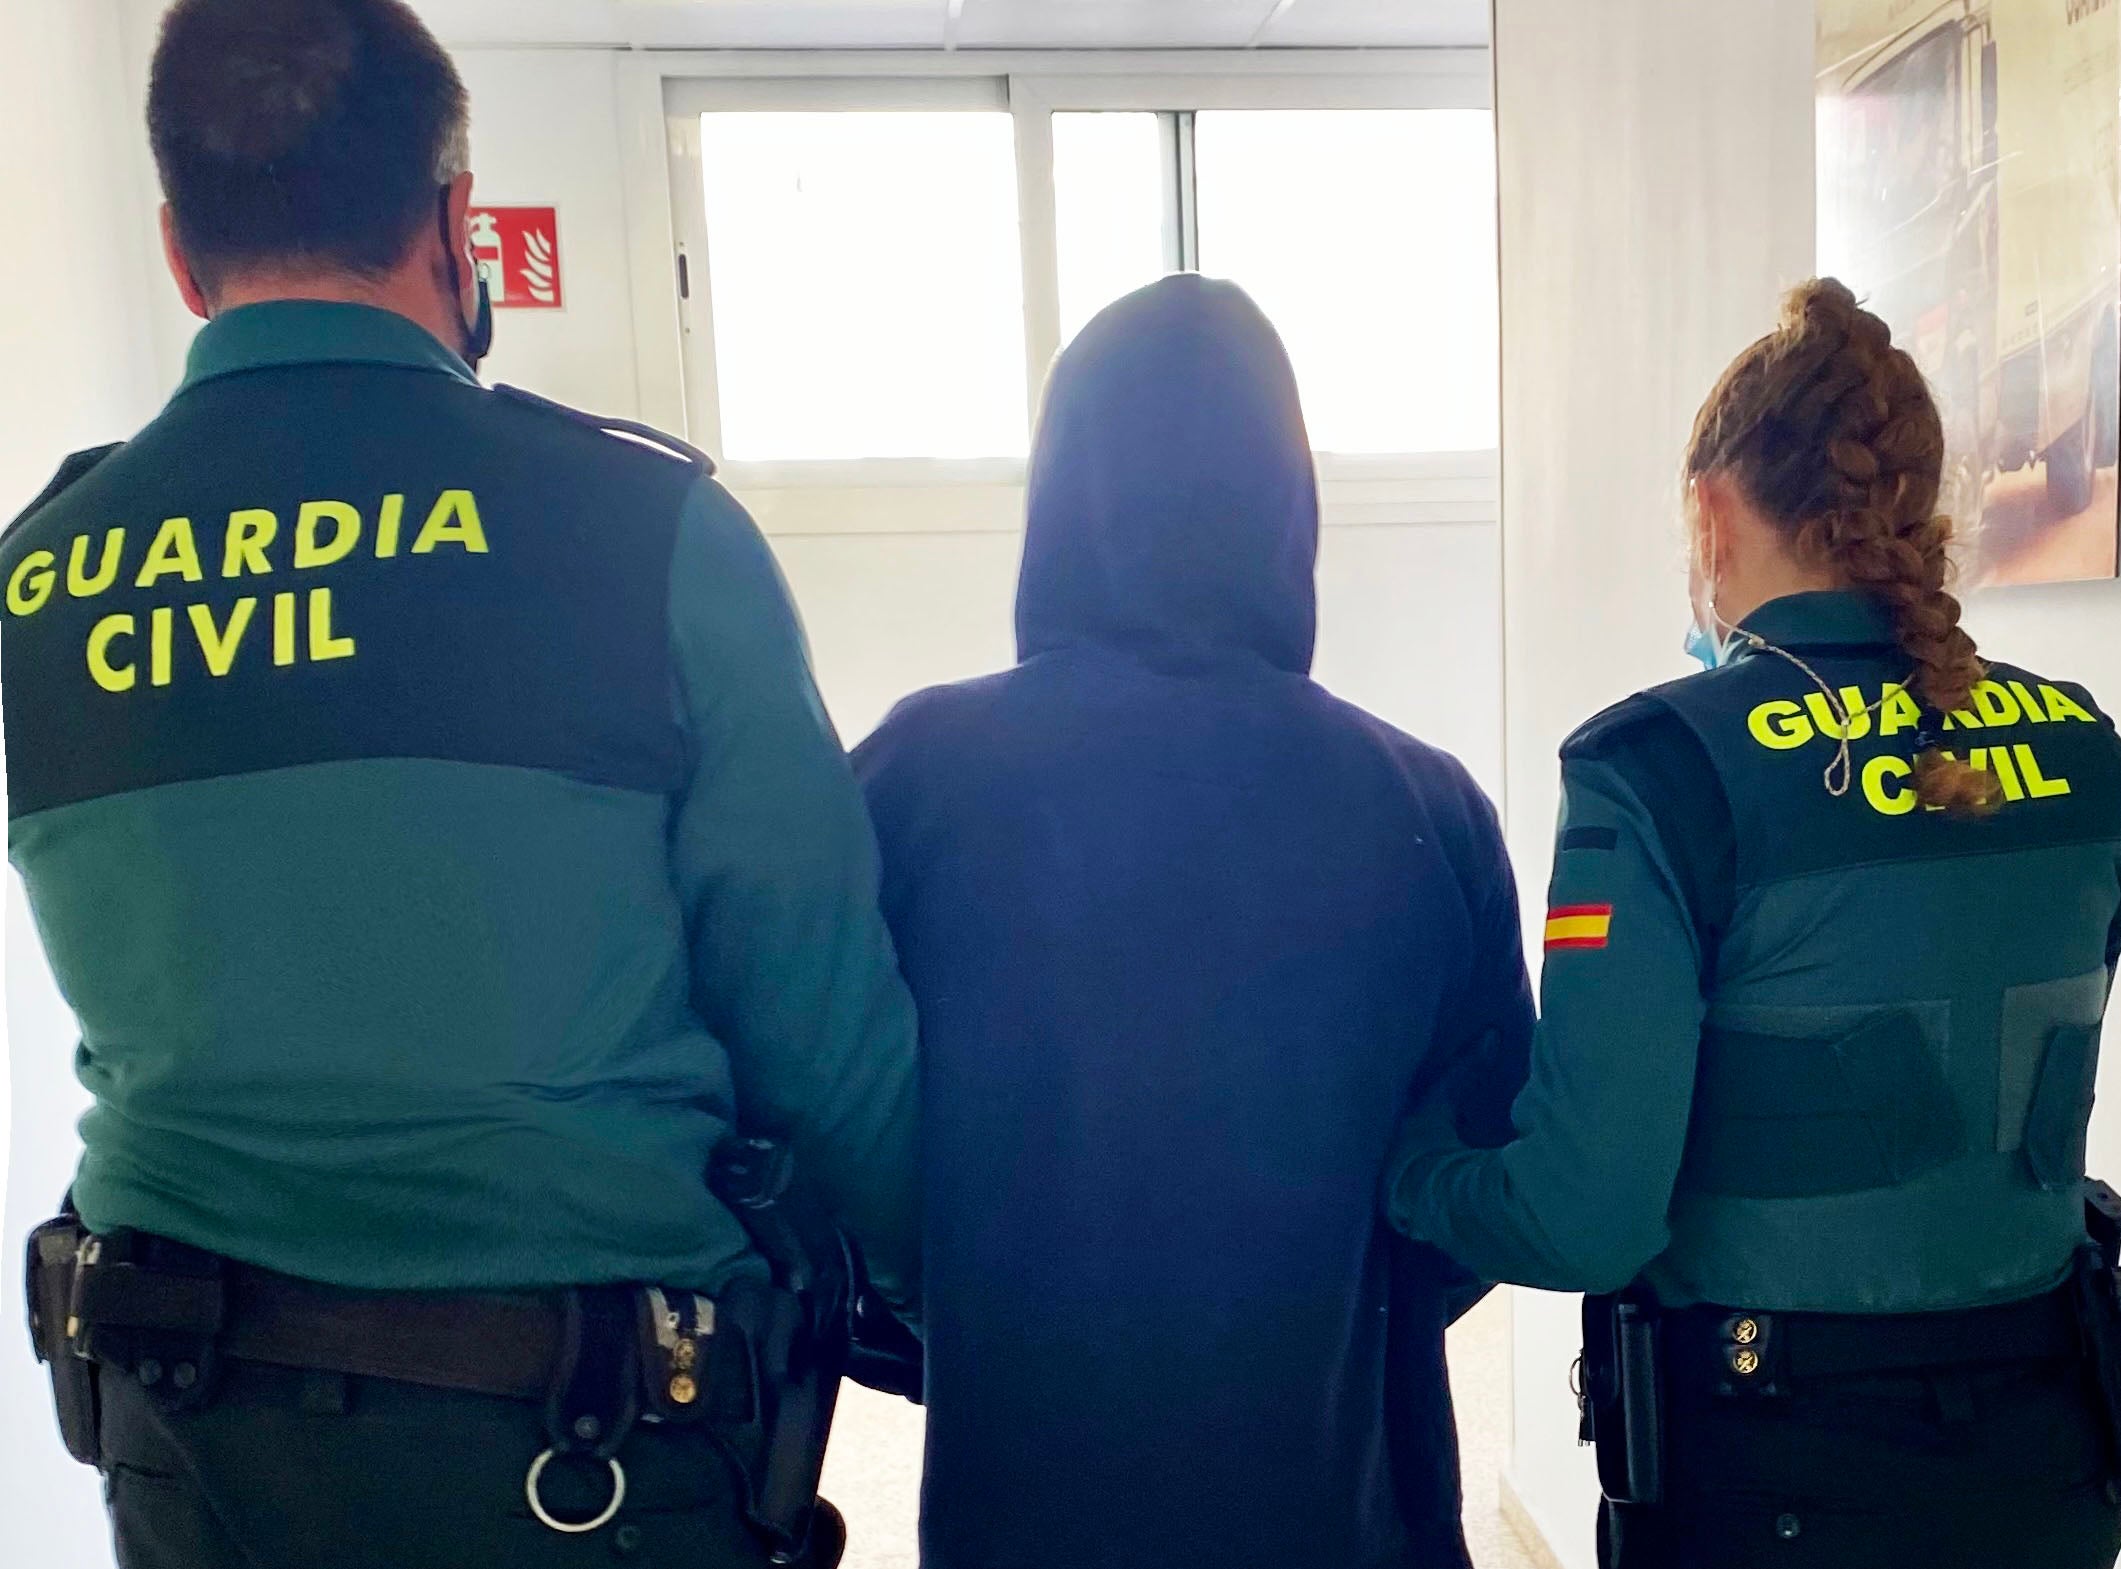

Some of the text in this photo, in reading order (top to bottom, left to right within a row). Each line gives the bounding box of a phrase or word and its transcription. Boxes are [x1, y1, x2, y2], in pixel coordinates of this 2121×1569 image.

[6, 489, 490, 617] GUARDIA
[86, 587, 356, 692] CIVIL
[1861, 743, 2072, 815] CIL
